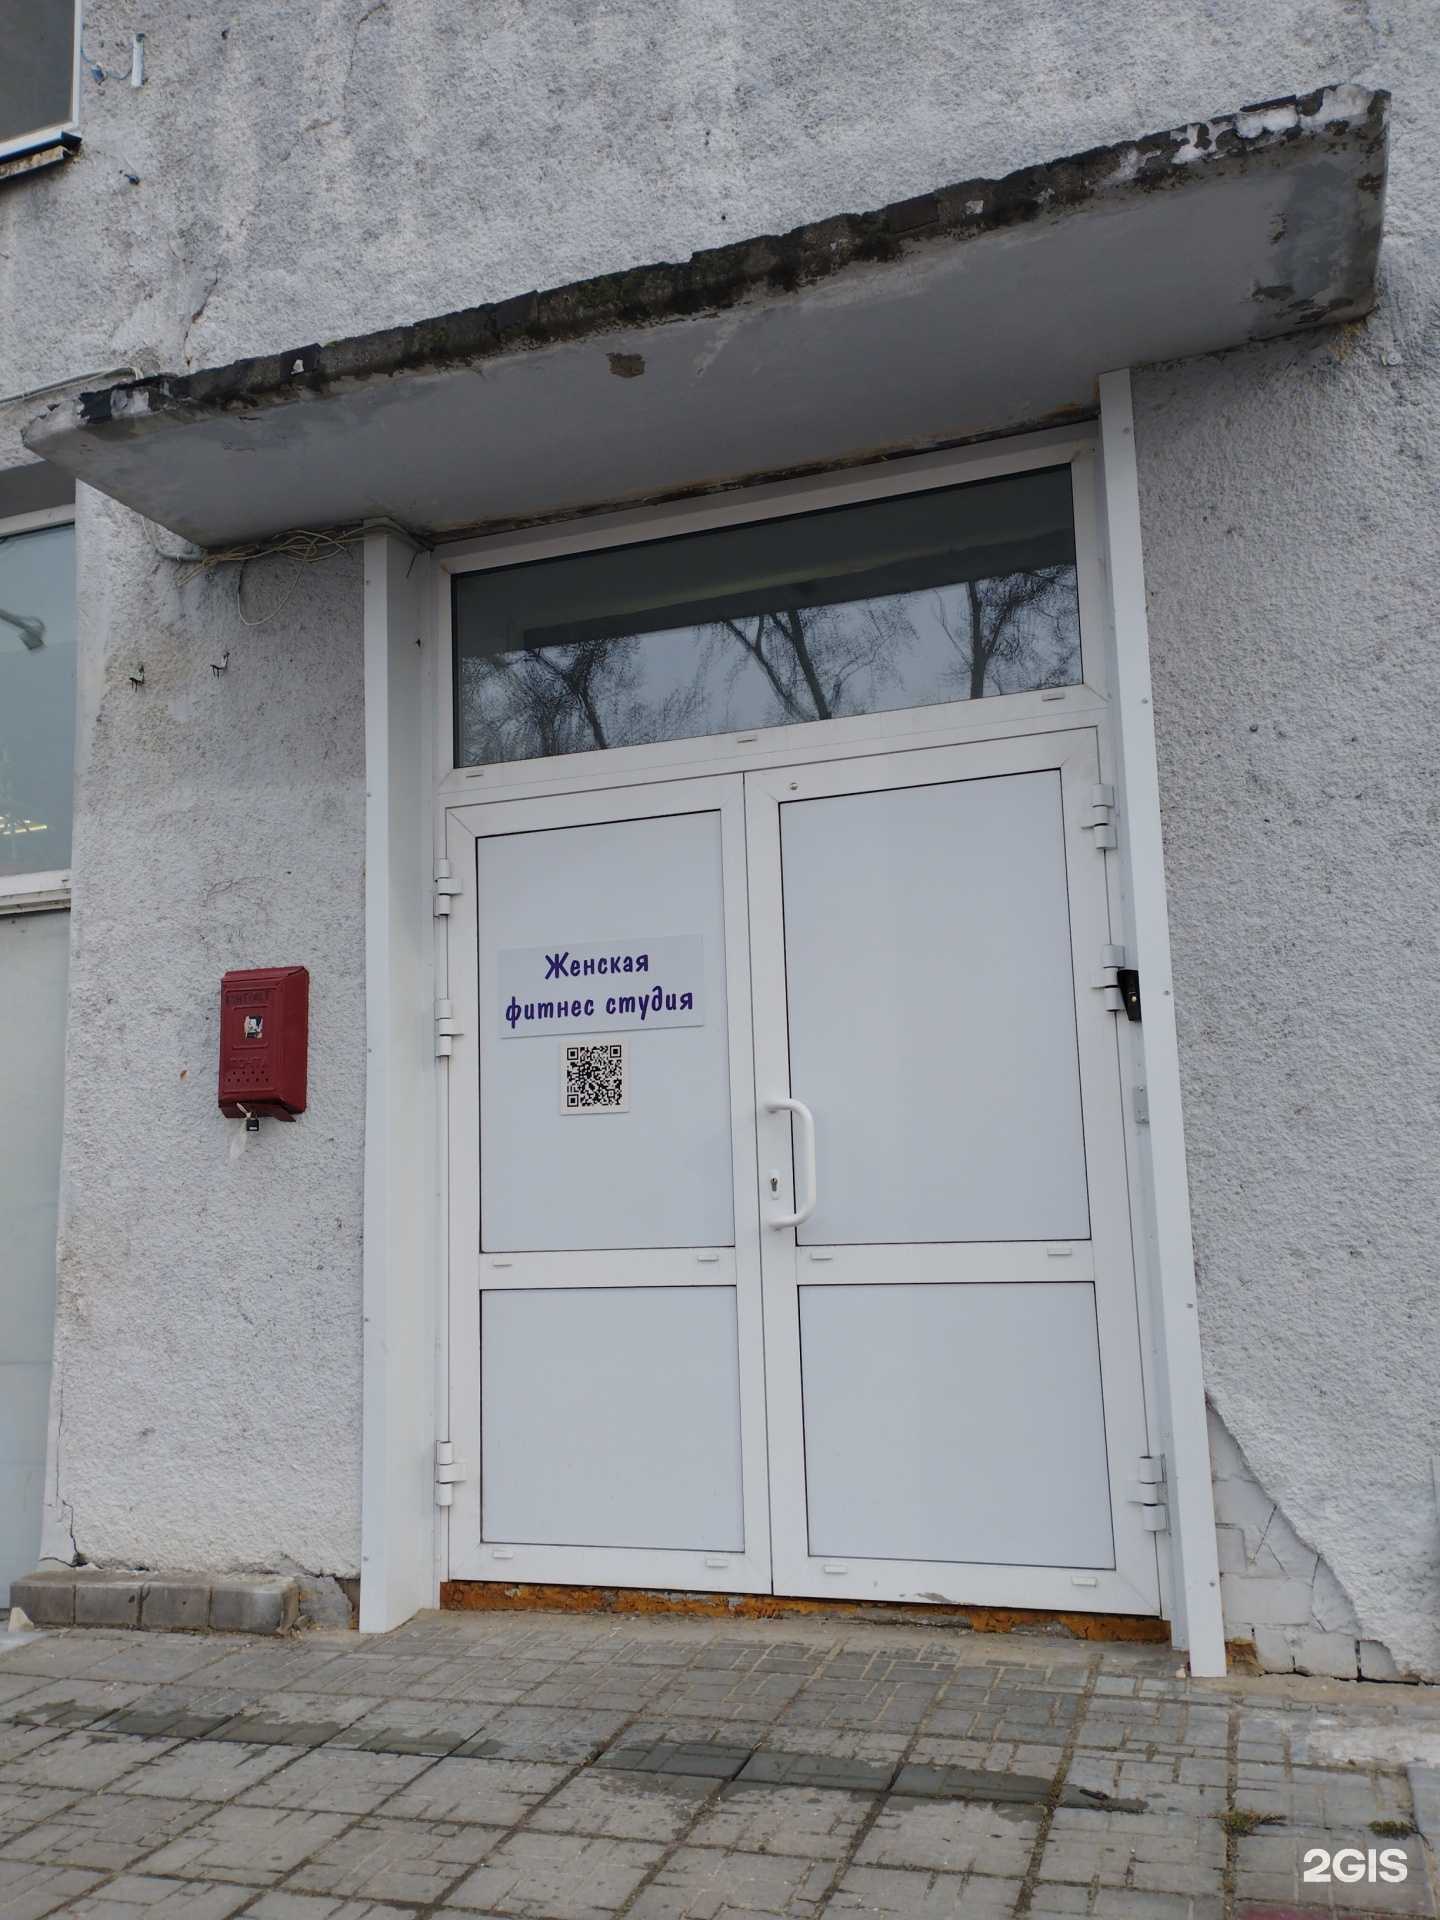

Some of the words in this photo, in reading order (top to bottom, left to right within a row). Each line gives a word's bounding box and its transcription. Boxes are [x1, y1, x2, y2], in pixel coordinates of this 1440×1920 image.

[544, 952, 649, 980] Женская
[505, 996, 595, 1029] фитнес
[605, 985, 693, 1021] студия
